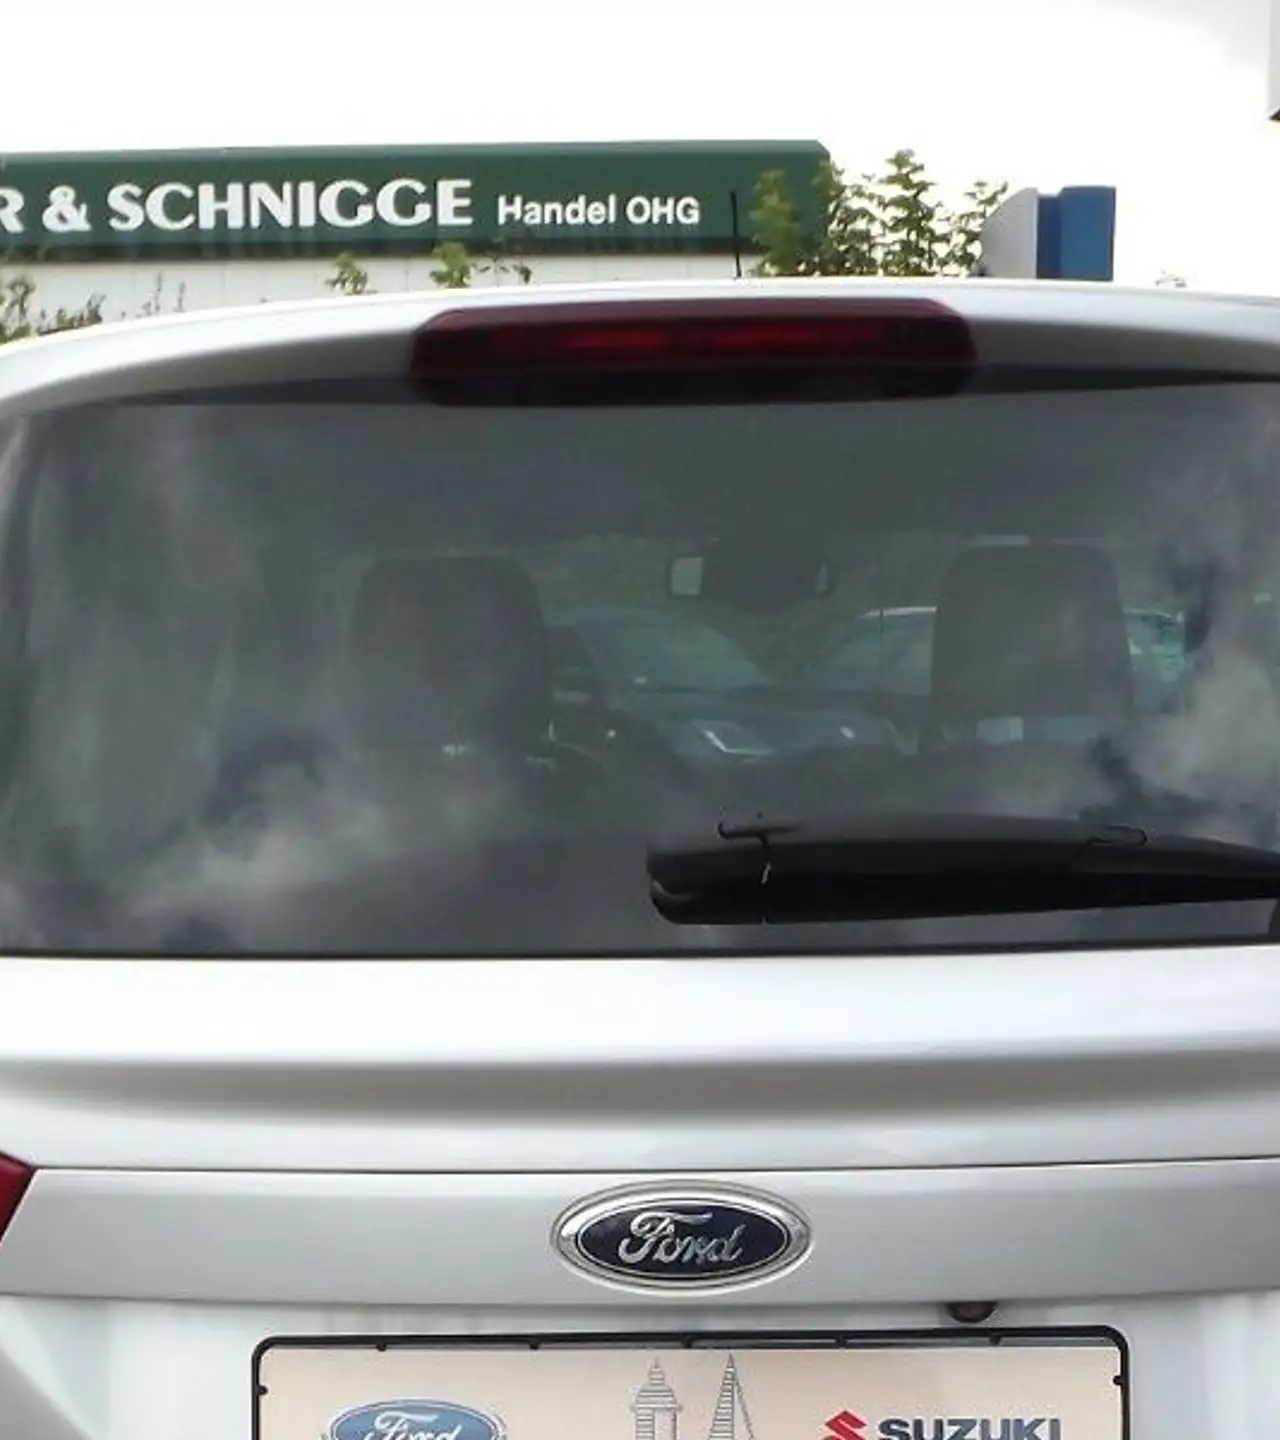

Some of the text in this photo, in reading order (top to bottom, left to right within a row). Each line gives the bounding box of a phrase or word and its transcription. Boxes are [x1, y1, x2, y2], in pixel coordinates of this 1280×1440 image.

[41, 185, 92, 233] &
[108, 178, 473, 231] SCHNIGGE
[497, 192, 616, 226] Handel
[625, 196, 701, 226] OHG
[617, 1210, 748, 1265] Ford
